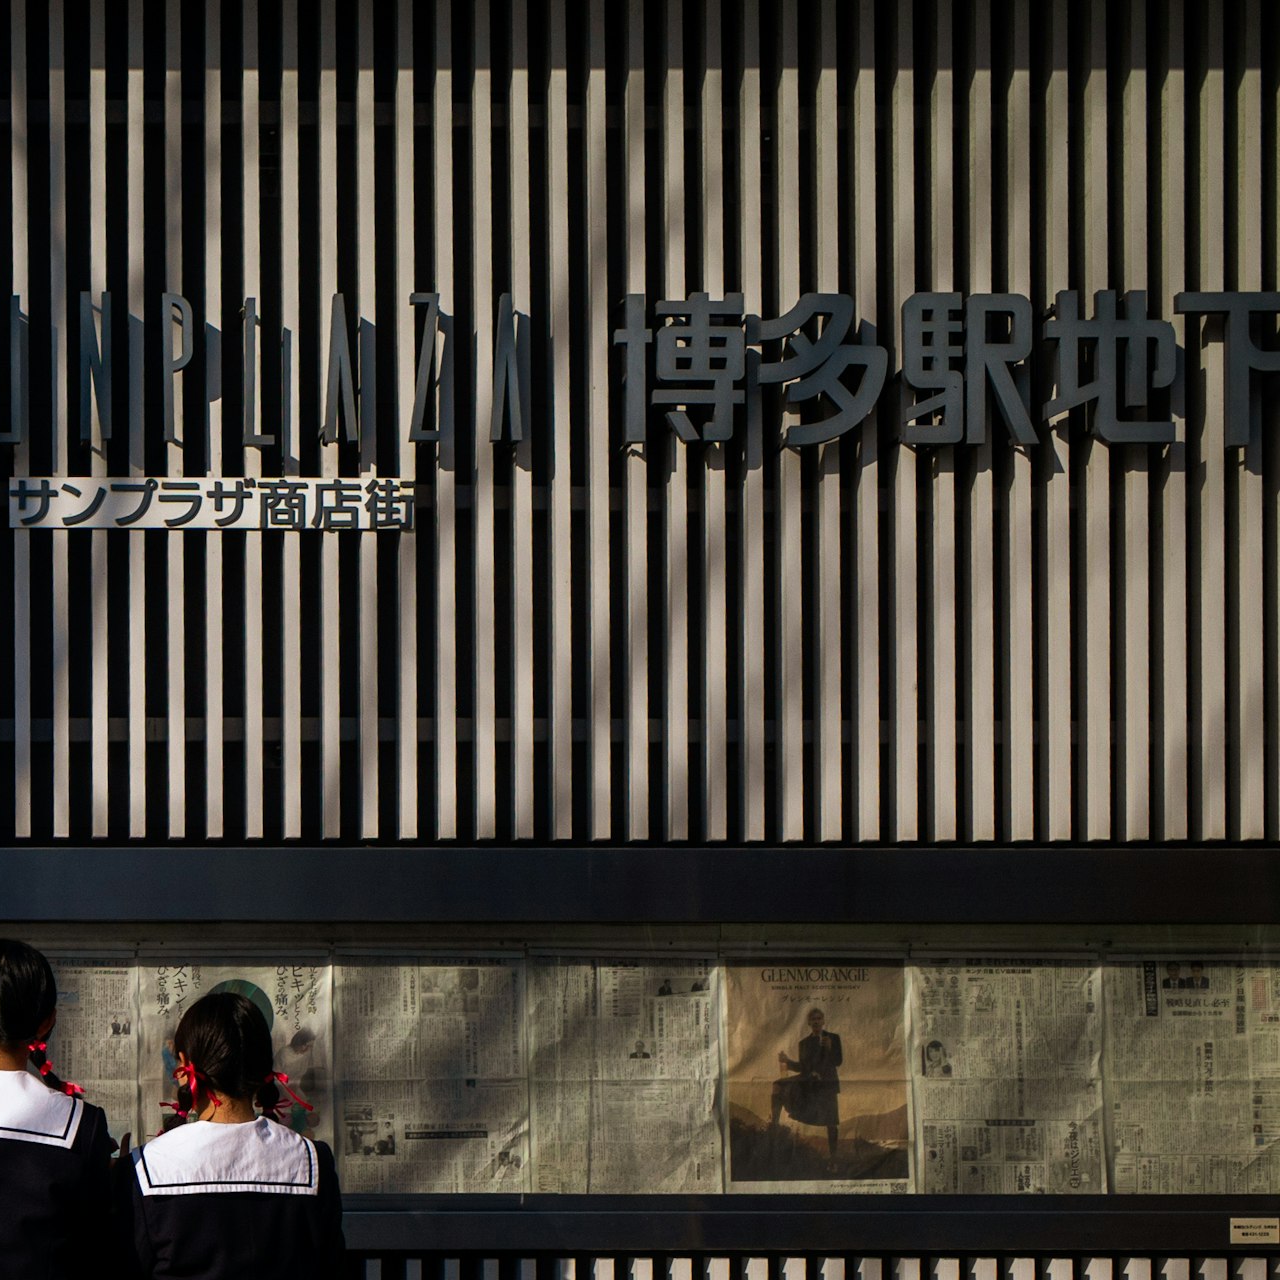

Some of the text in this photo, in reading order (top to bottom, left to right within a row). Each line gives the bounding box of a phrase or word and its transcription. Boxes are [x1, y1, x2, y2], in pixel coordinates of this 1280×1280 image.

[613, 290, 1280, 447] 博多駅地下
[10, 479, 414, 530] サンプラザ商店街
[761, 968, 869, 982] GLENMORANGIE
